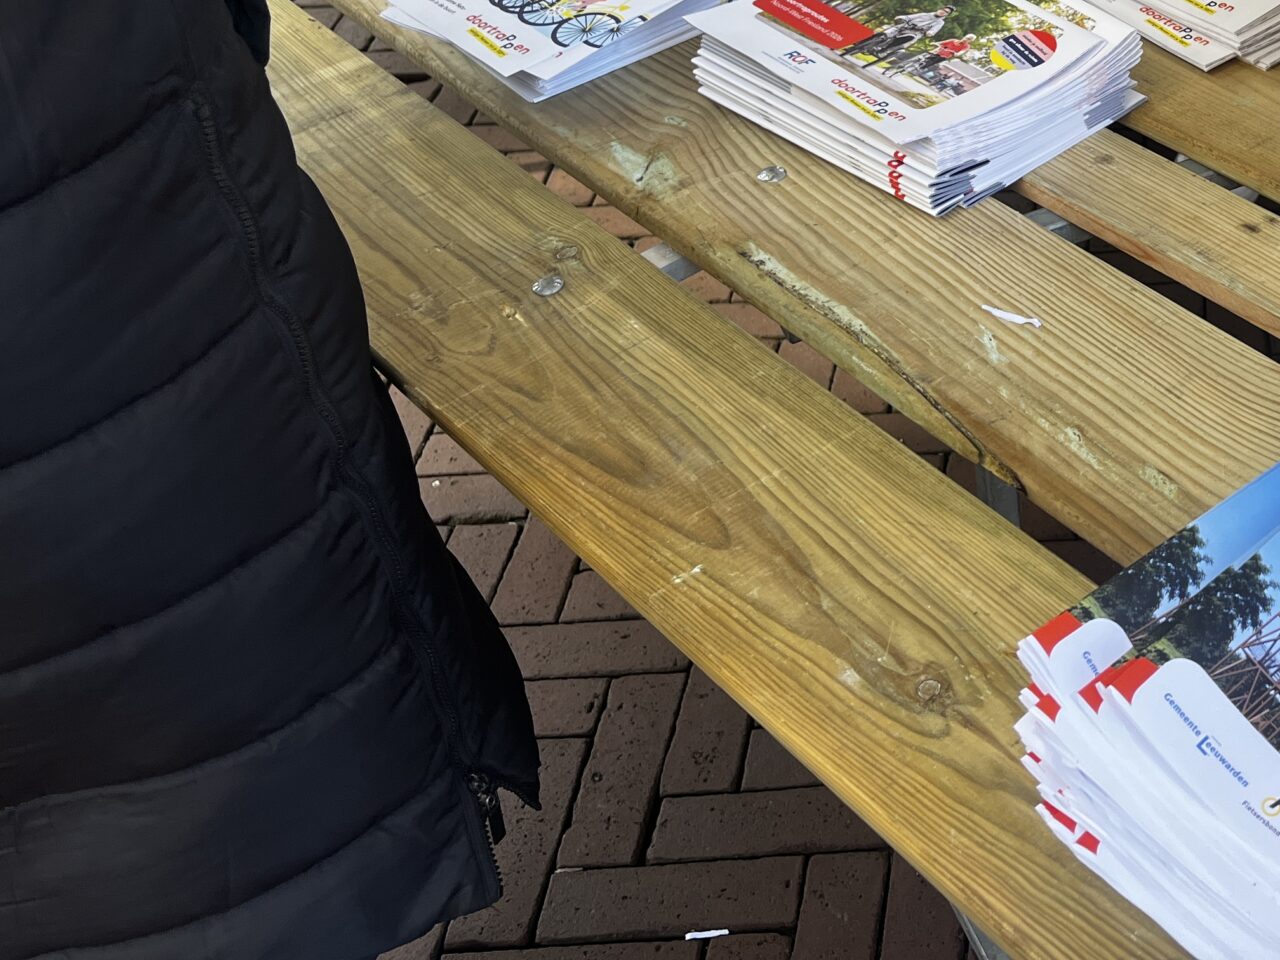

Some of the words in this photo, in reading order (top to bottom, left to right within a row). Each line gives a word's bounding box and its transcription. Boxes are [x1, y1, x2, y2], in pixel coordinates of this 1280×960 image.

[1139, 5, 1210, 47] doortrappen
[831, 78, 906, 121] doortrappen
[1164, 693, 1202, 736] Gemeente
[1197, 735, 1249, 787] Leeuwarden
